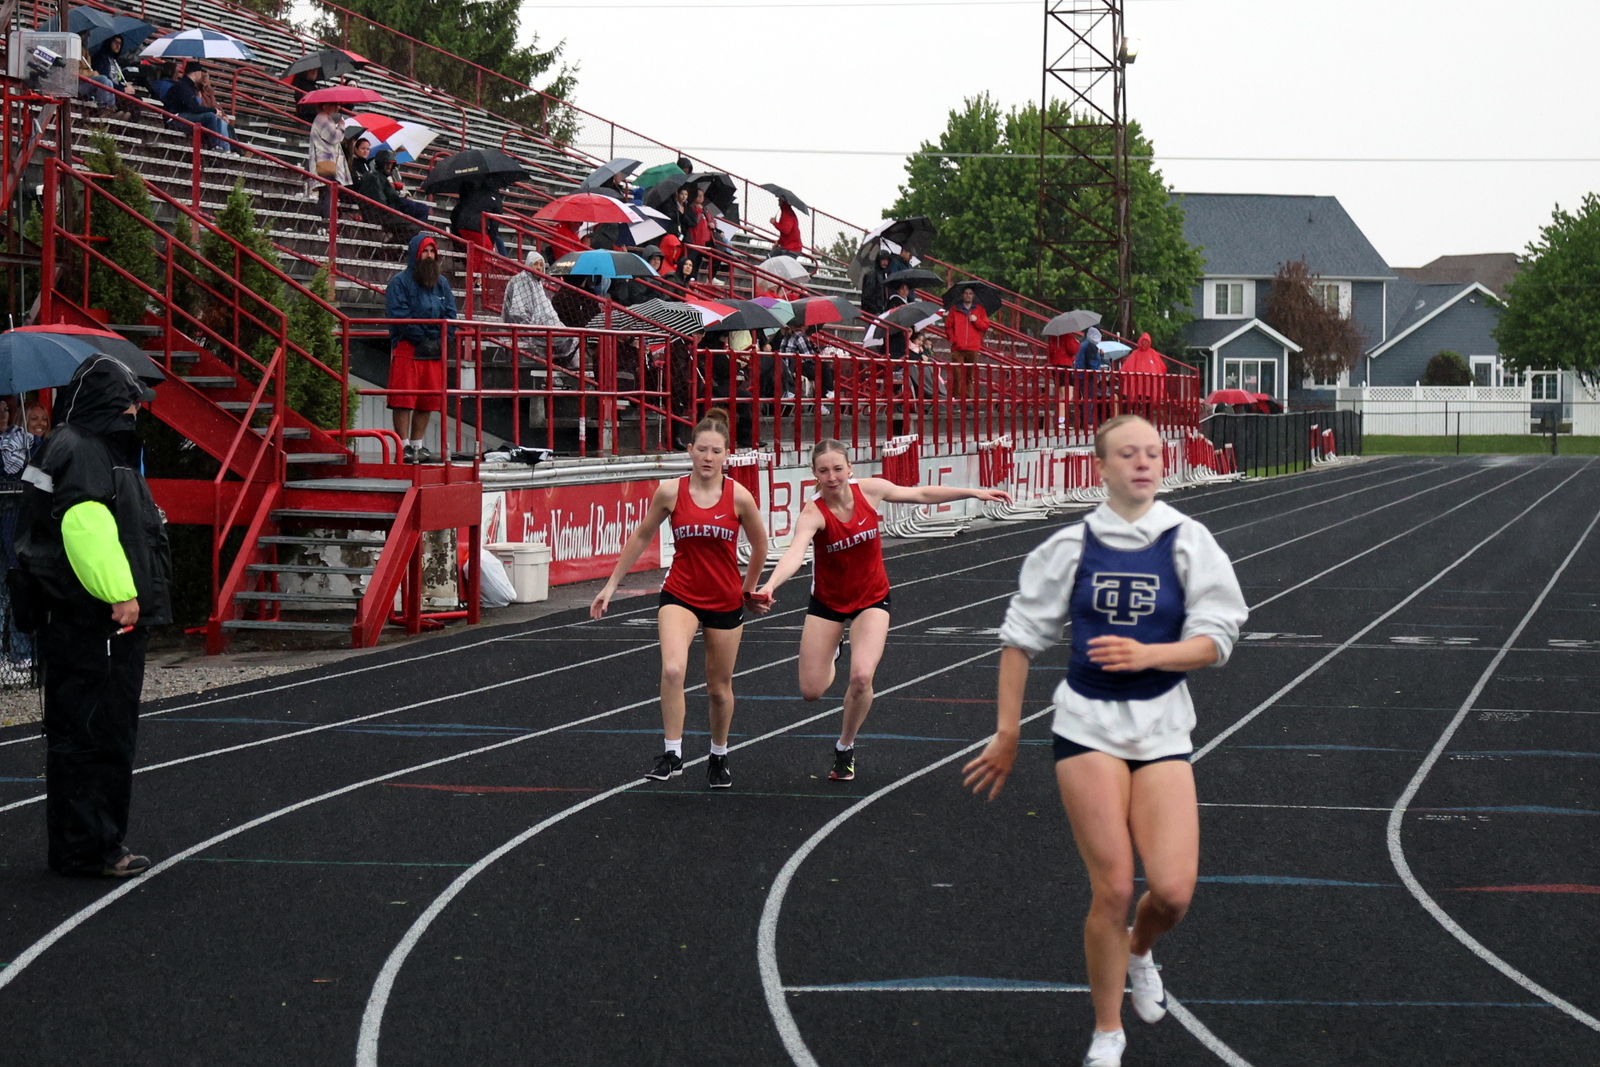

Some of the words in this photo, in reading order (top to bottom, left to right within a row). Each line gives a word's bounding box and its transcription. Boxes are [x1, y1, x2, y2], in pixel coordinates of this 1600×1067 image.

[550, 501, 594, 562] National
[595, 500, 622, 556] Bank
[674, 524, 734, 541] BELLEVUE
